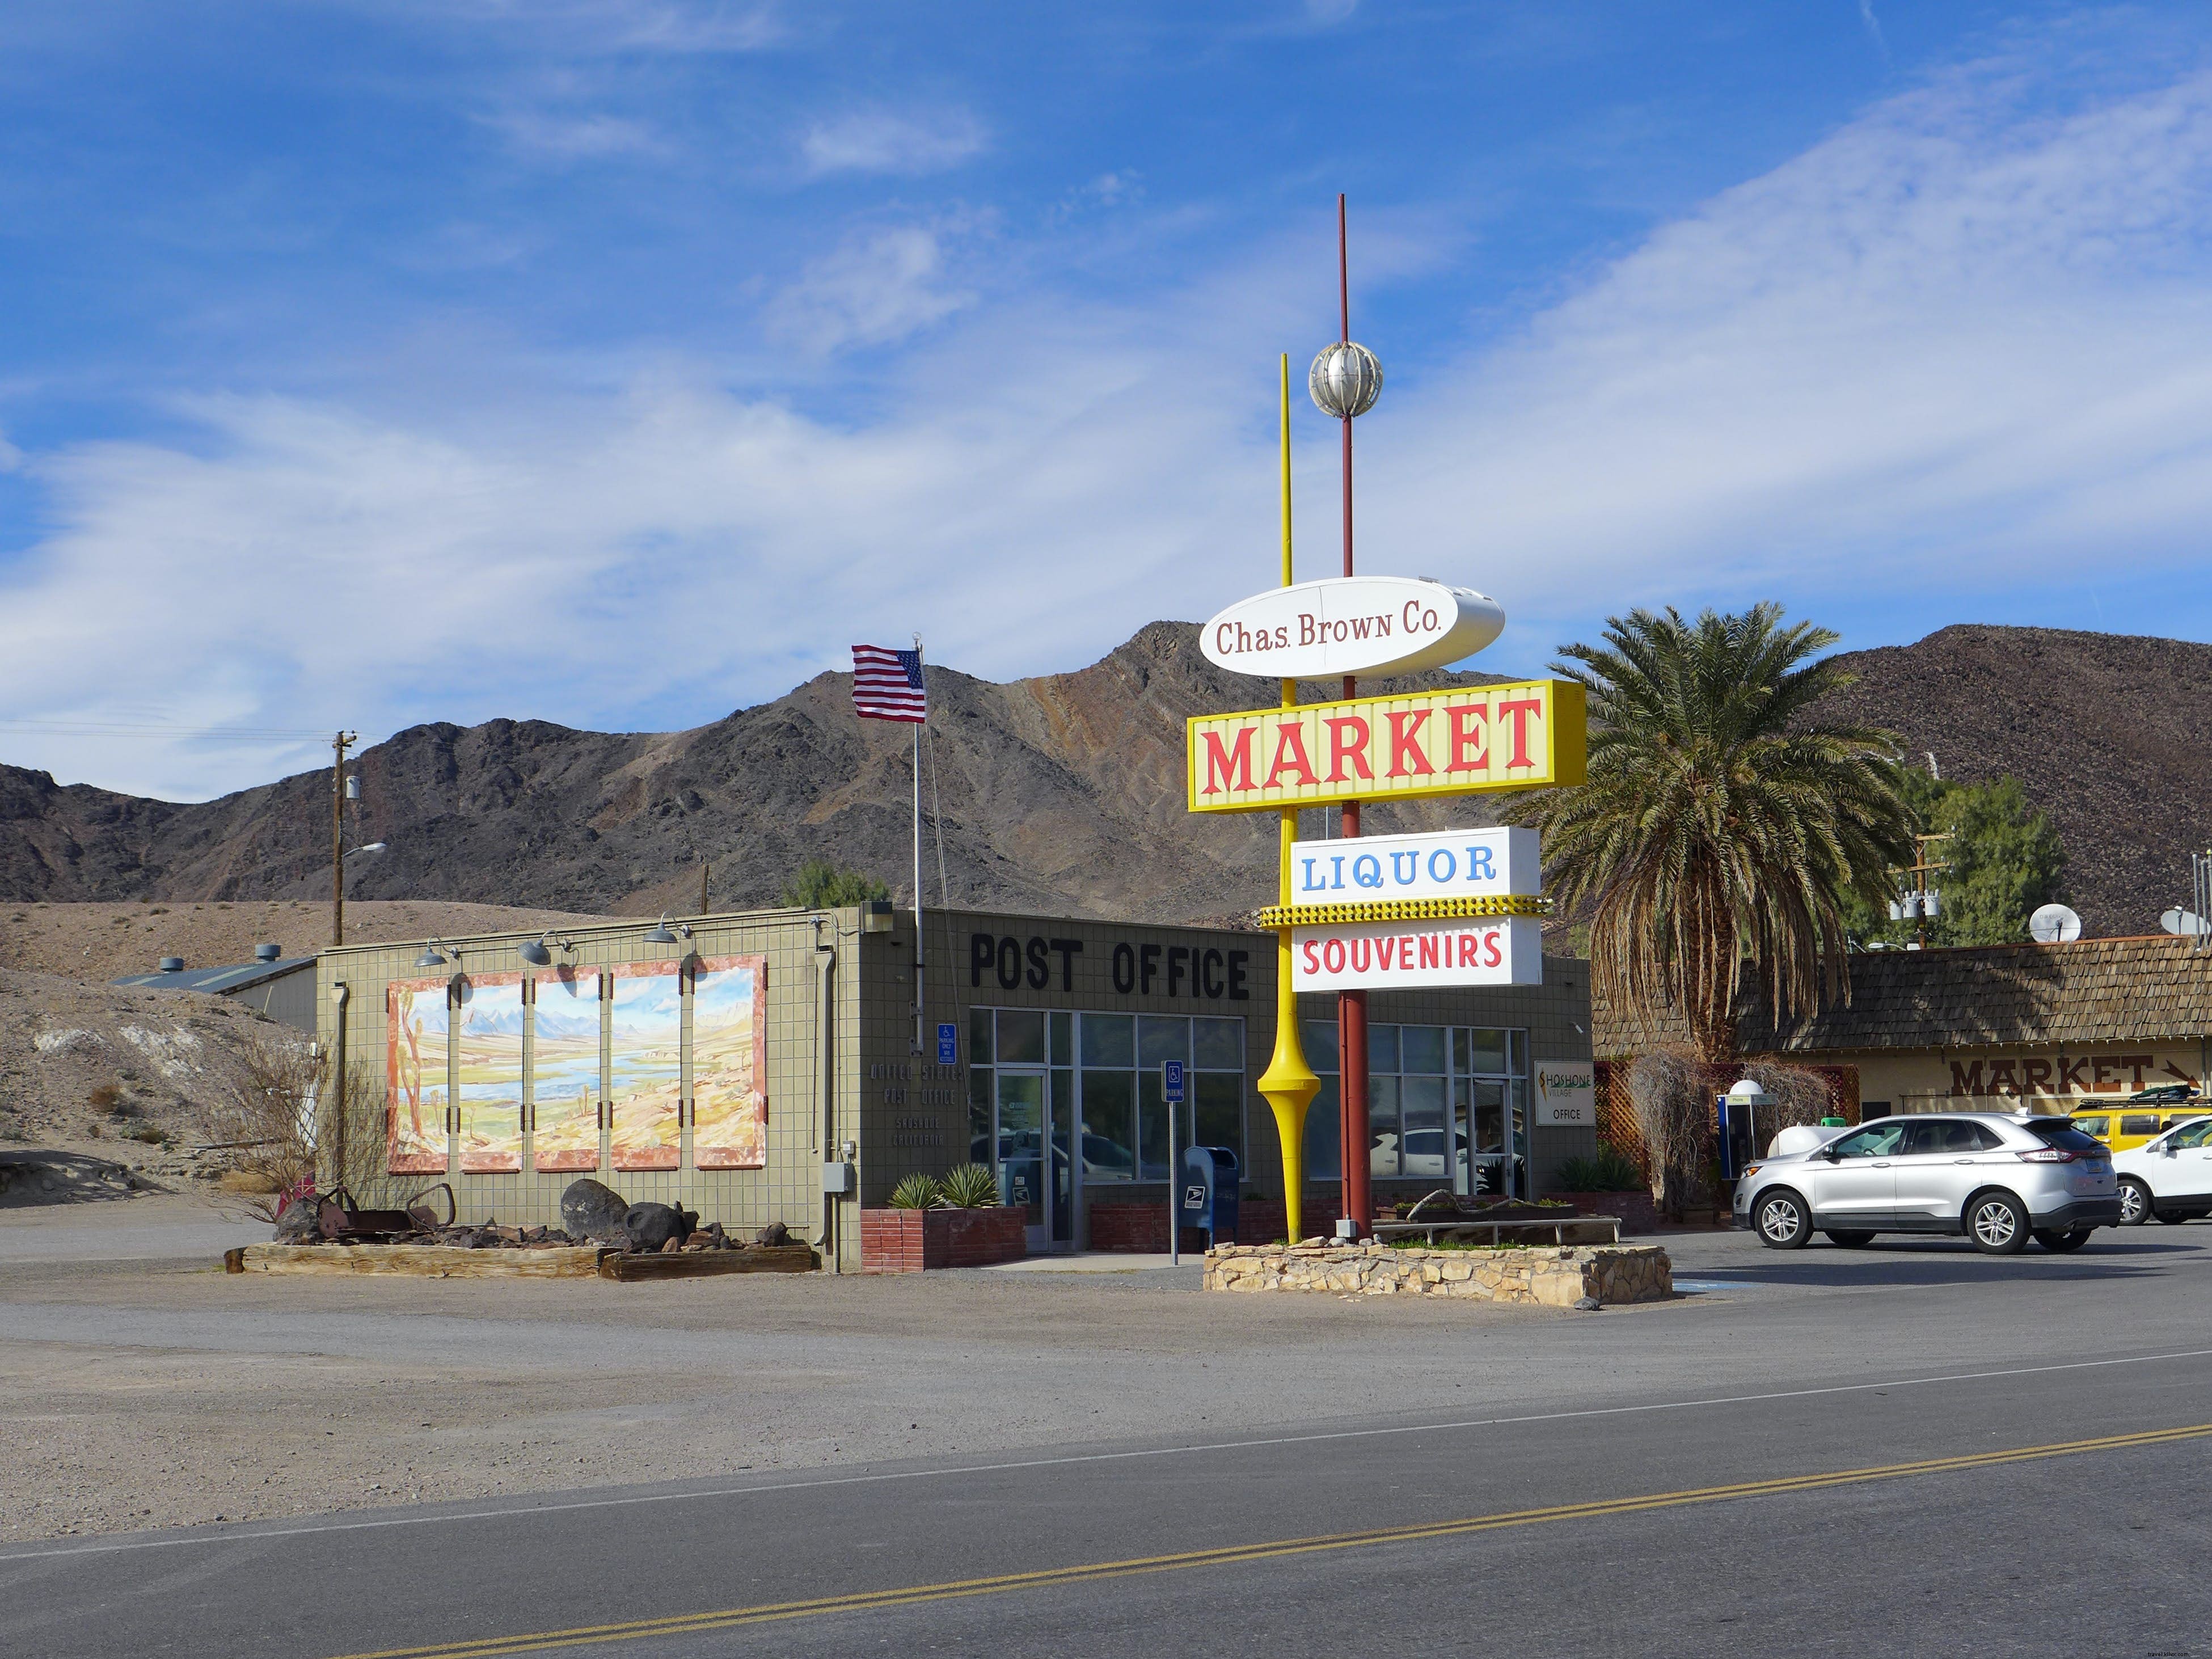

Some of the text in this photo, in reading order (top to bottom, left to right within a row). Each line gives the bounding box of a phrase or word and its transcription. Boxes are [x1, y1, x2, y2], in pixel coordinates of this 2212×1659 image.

[1217, 621, 1291, 655] Chas.
[1403, 600, 1441, 634] Co.
[1200, 699, 1541, 795] MARKET
[1302, 846, 1496, 891] LIQUOR
[971, 934, 1248, 1000] POST OFFICE
[1303, 931, 1502, 974] SOUVENIRS
[871, 1064, 912, 1080] UNITED
[1539, 1071, 1591, 1087] SHOSHONE
[1950, 1055, 2154, 1096] MARKET
[884, 1088, 955, 1104] POST OFFICE
[1554, 1109, 1580, 1120] OFFICE
[896, 1118, 940, 1129] SHOSHONE
